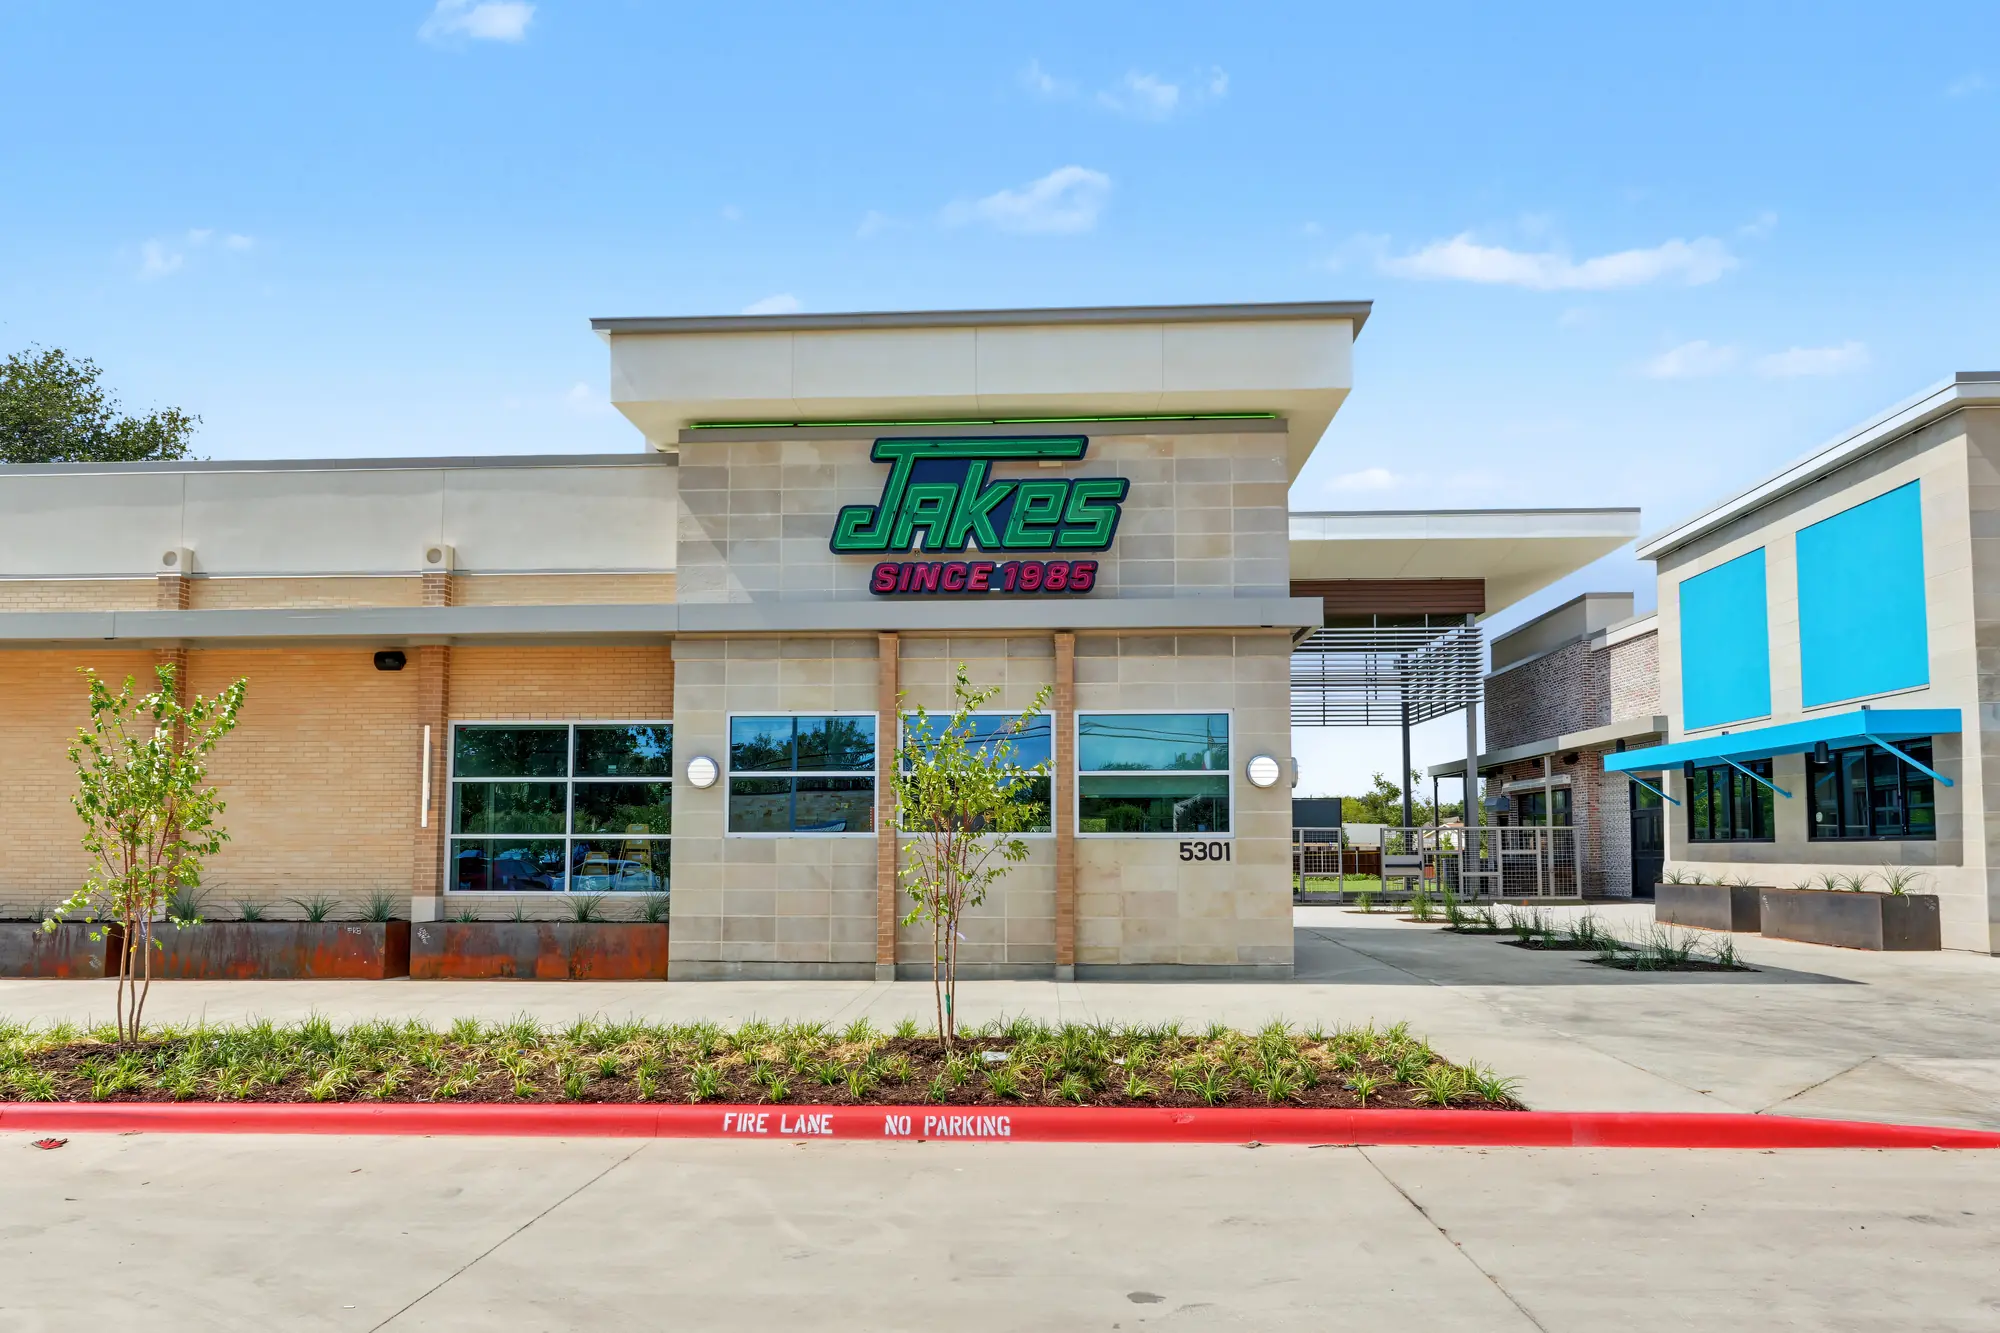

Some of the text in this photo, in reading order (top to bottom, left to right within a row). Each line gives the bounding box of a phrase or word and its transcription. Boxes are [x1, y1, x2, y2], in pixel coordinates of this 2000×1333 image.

[873, 562, 1096, 592] SINCE 1985
[1179, 841, 1231, 861] 5301
[723, 1112, 1011, 1137] FIRE LANE NO PARKING
